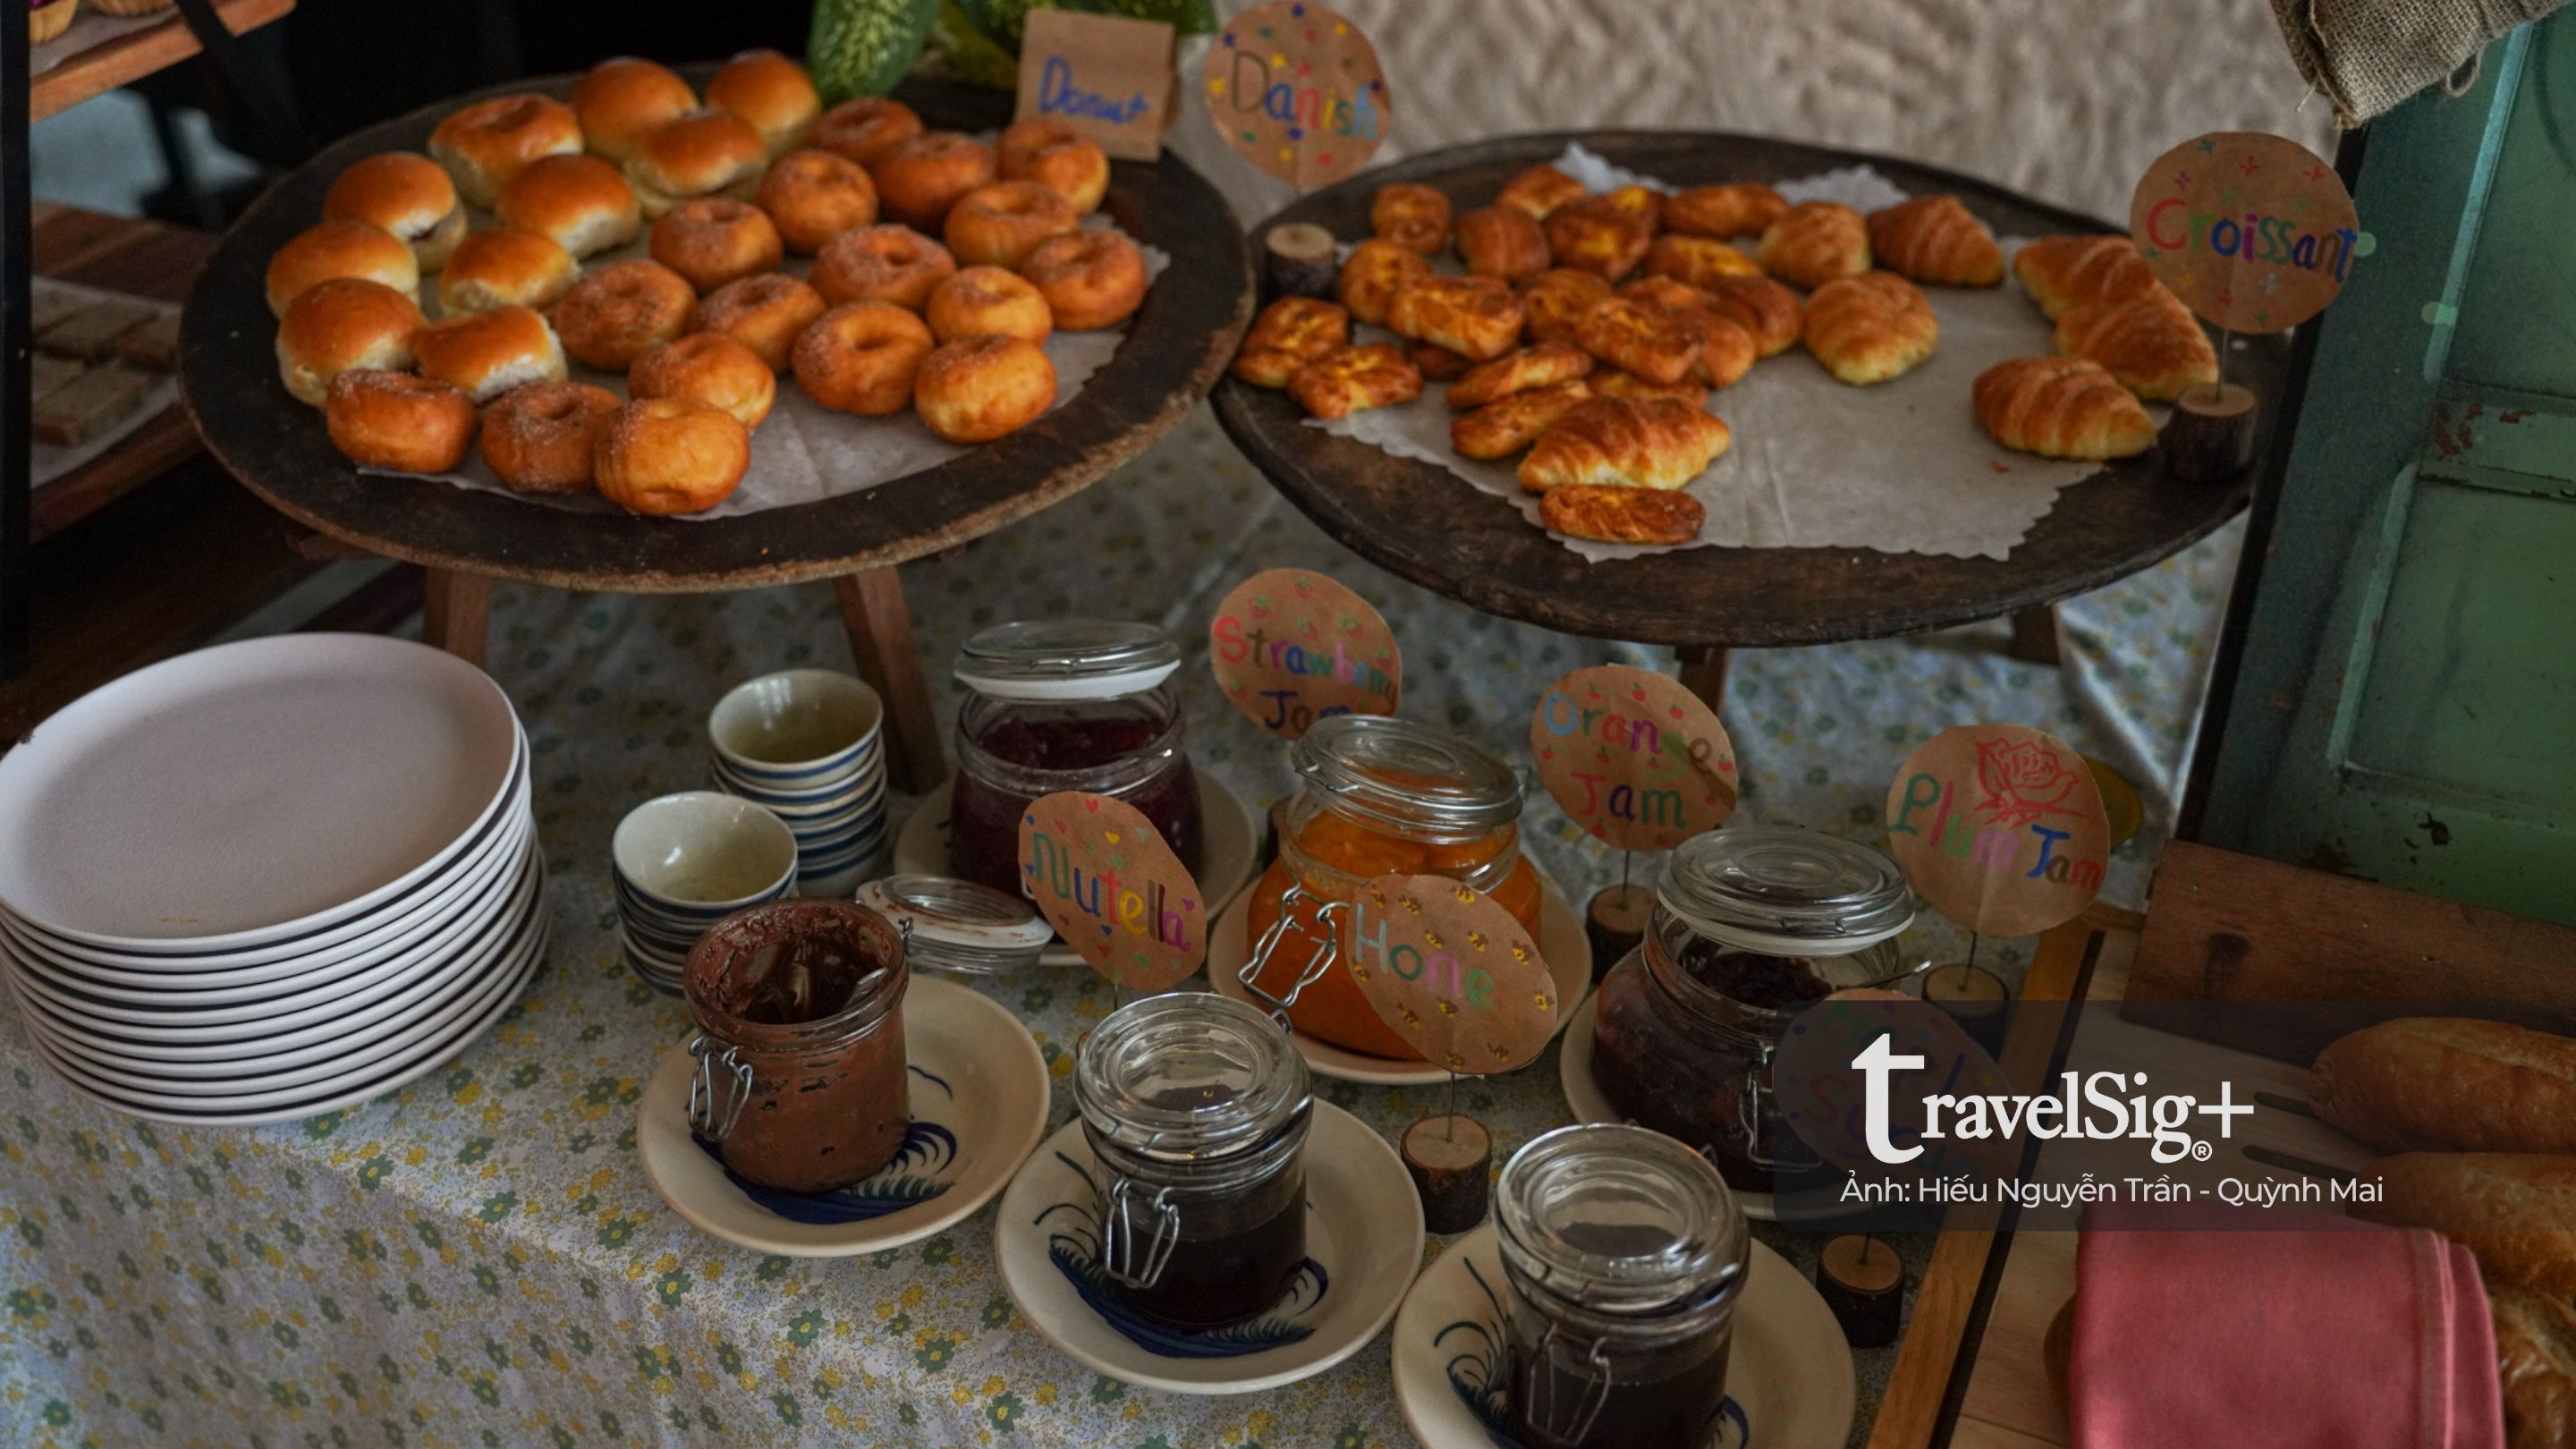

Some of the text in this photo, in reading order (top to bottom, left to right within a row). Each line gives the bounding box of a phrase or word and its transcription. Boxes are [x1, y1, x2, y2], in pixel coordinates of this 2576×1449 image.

[1232, 50, 1378, 140] Danish
[2147, 198, 2358, 284] Croissant
[1544, 691, 1713, 779] Orange
[1570, 771, 1688, 829] Jam
[1888, 772, 2101, 890] Plum Jam
[1033, 832, 1191, 953] Nutella
